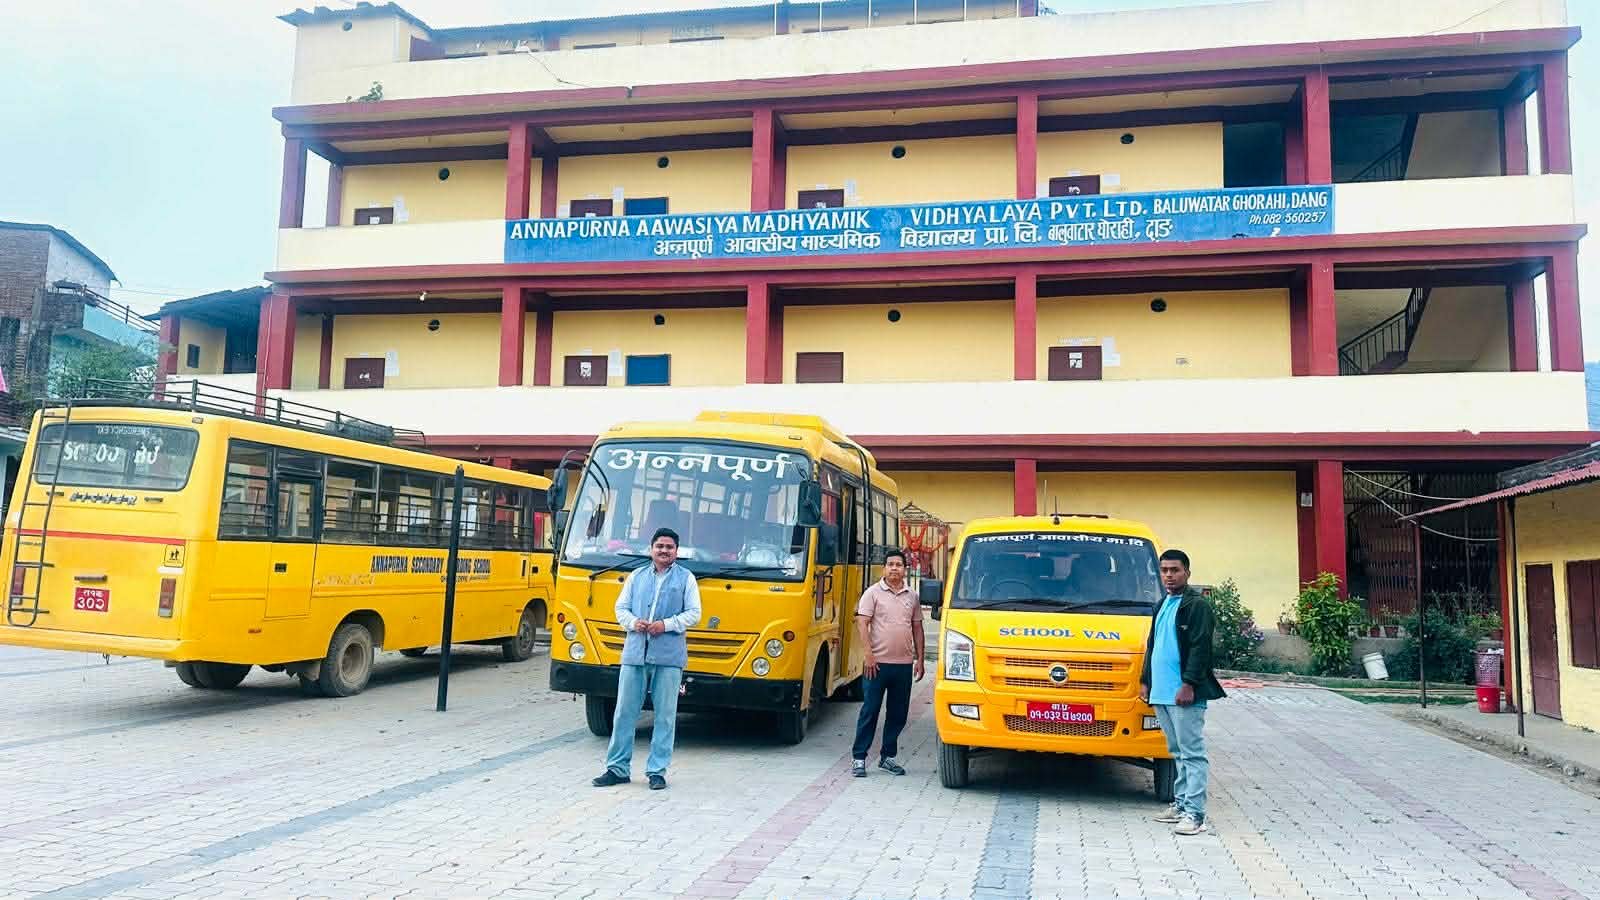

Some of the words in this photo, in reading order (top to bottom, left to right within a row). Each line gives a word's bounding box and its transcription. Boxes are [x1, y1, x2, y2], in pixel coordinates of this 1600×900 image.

[510, 219, 631, 239] ANNAPURNA
[636, 215, 737, 237] AAWASIYA
[742, 209, 871, 233] MADHYAMIK
[910, 202, 1042, 226] VIDHYALAYA
[1050, 202, 1097, 220] PVT.
[1103, 199, 1148, 217] LTD.
[1153, 195, 1231, 215] BALUWATAR
[1291, 191, 1328, 209] DANG
[653, 235, 713, 259] अन्नपूर्ण
[724, 233, 799, 253] आवासीय
[800, 229, 881, 251] माध्यमिक
[899, 226, 976, 248] विद्यालय
[607, 448, 793, 481] अन्नपूर्ण
[999, 627, 1075, 638] SCHOOL
[1083, 629, 1120, 640] VAN
